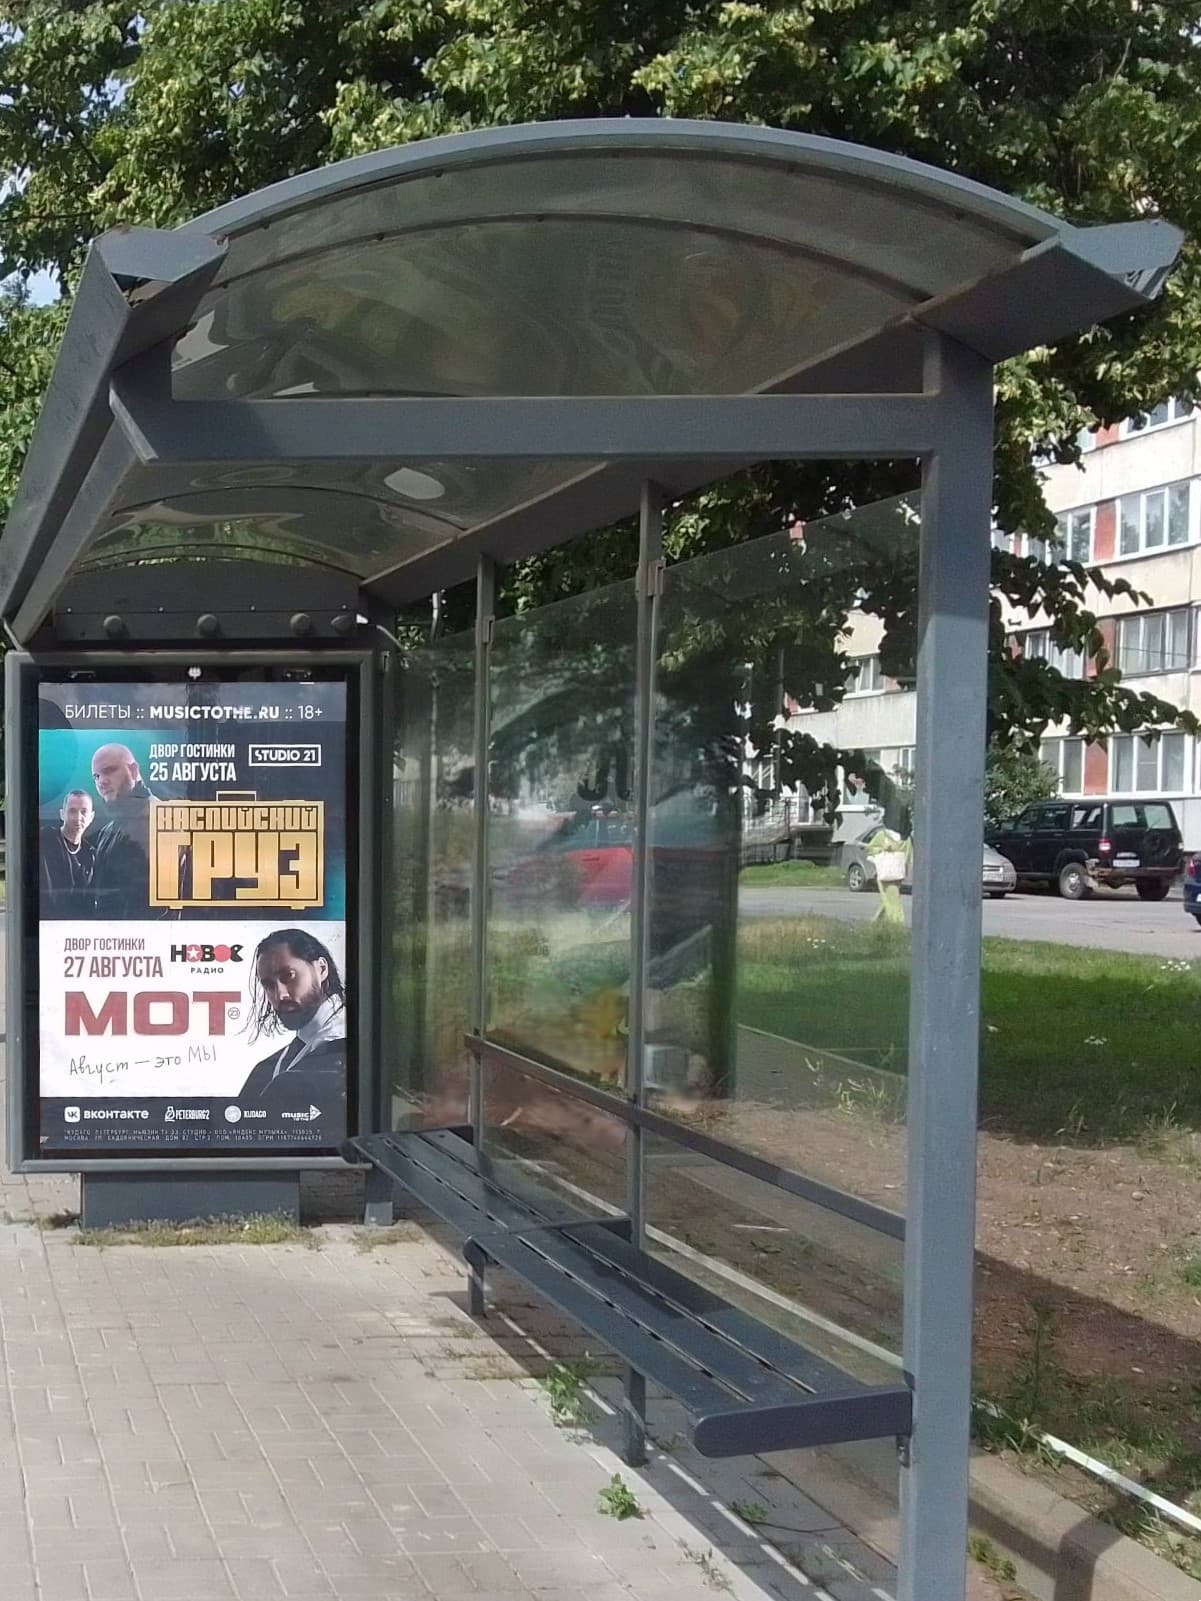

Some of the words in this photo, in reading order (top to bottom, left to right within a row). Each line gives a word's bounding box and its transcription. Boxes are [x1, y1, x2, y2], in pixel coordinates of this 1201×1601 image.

[65, 705, 131, 719] БИЛЕТЫ
[150, 705, 279, 719] MUSICTOTHE.RU
[298, 705, 323, 719] 18+
[149, 744, 178, 759] ДВОР
[180, 744, 235, 758] ГОСТИНКИ
[255, 750, 301, 761] STUDIO
[303, 750, 316, 761] 21
[150, 763, 167, 781] 25
[172, 762, 237, 781] АВГУСТА
[157, 807, 317, 830] КАСПИЙСКИЙ
[157, 831, 317, 900] ГРУЗ
[64, 938, 91, 952] ДВОР
[93, 938, 145, 951] ГОСТИНКИ
[64, 956, 85, 977] 27
[89, 956, 163, 977] АВГУСТА
[65, 991, 241, 1036] МОТ
[70, 1056, 128, 1084] Август
[154, 1056, 181, 1068] это
